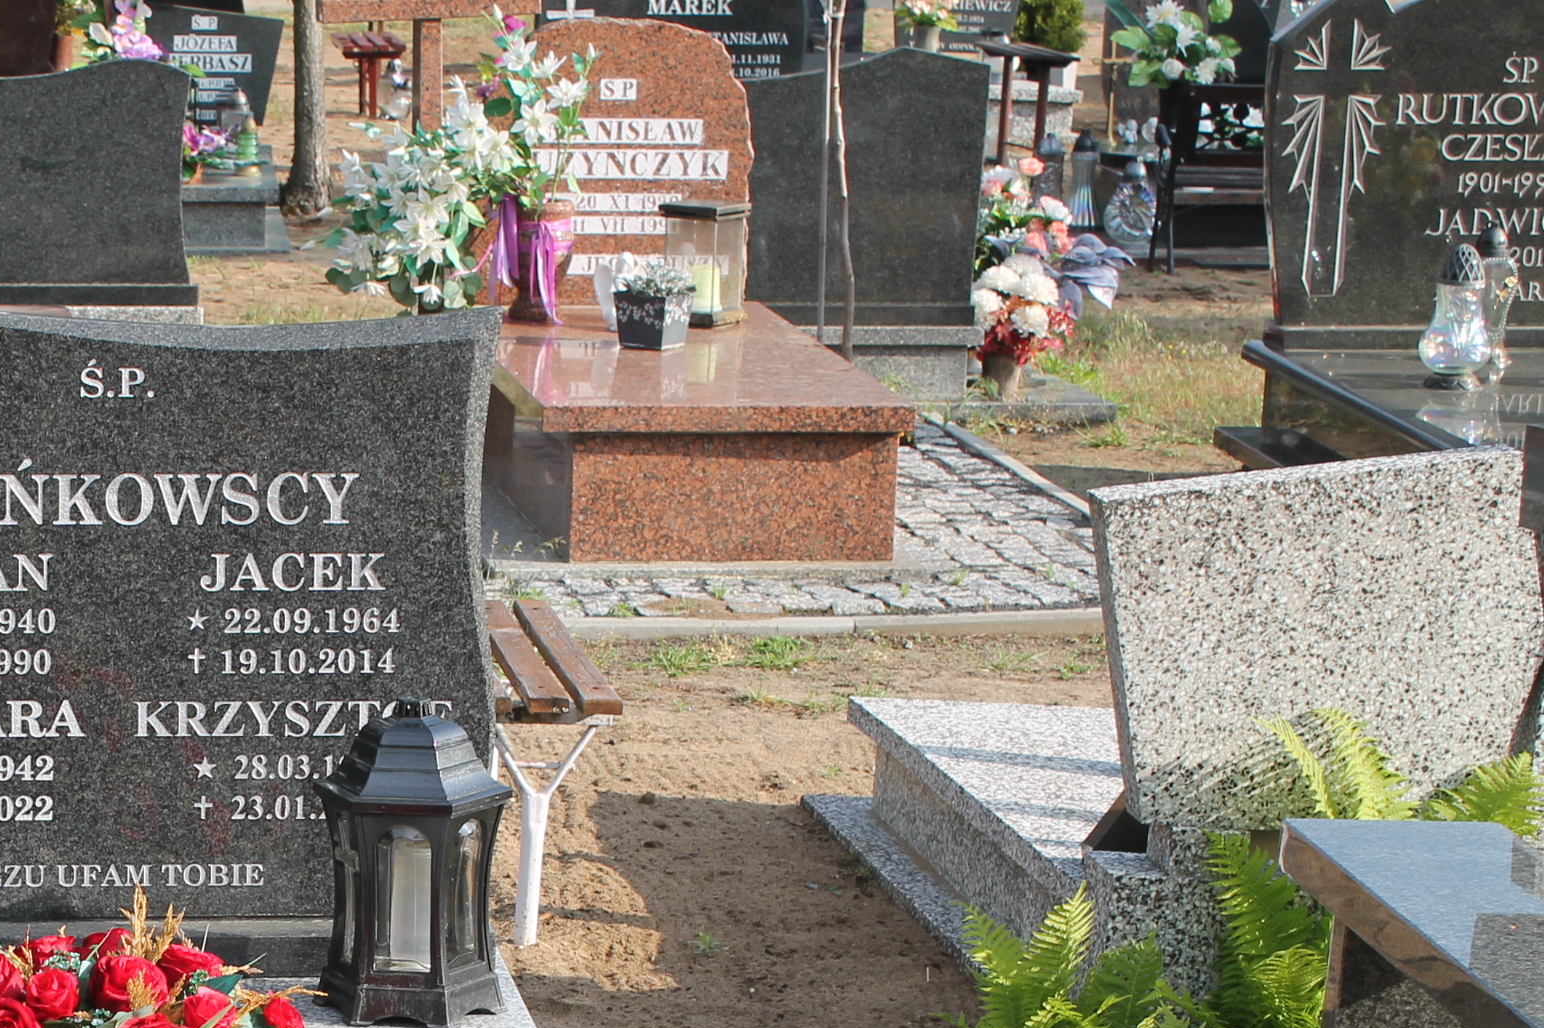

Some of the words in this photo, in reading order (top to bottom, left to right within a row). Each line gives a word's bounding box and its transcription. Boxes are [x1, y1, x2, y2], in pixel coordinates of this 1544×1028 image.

[646, 0, 734, 16] MAREK
[731, 67, 781, 78] .10.2016
[1441, 133, 1544, 162] CZESŁ
[1424, 208, 1544, 236] JADWI
[80, 358, 155, 399] Ś.P.
[199, 552, 387, 592] JACEK
[223, 607, 401, 635] 22.09.1964
[220, 647, 396, 675] 19.10.2014
[233, 754, 345, 780] 28.03.1
[56, 864, 153, 888] UFAM
[161, 863, 265, 888] TOBIE
